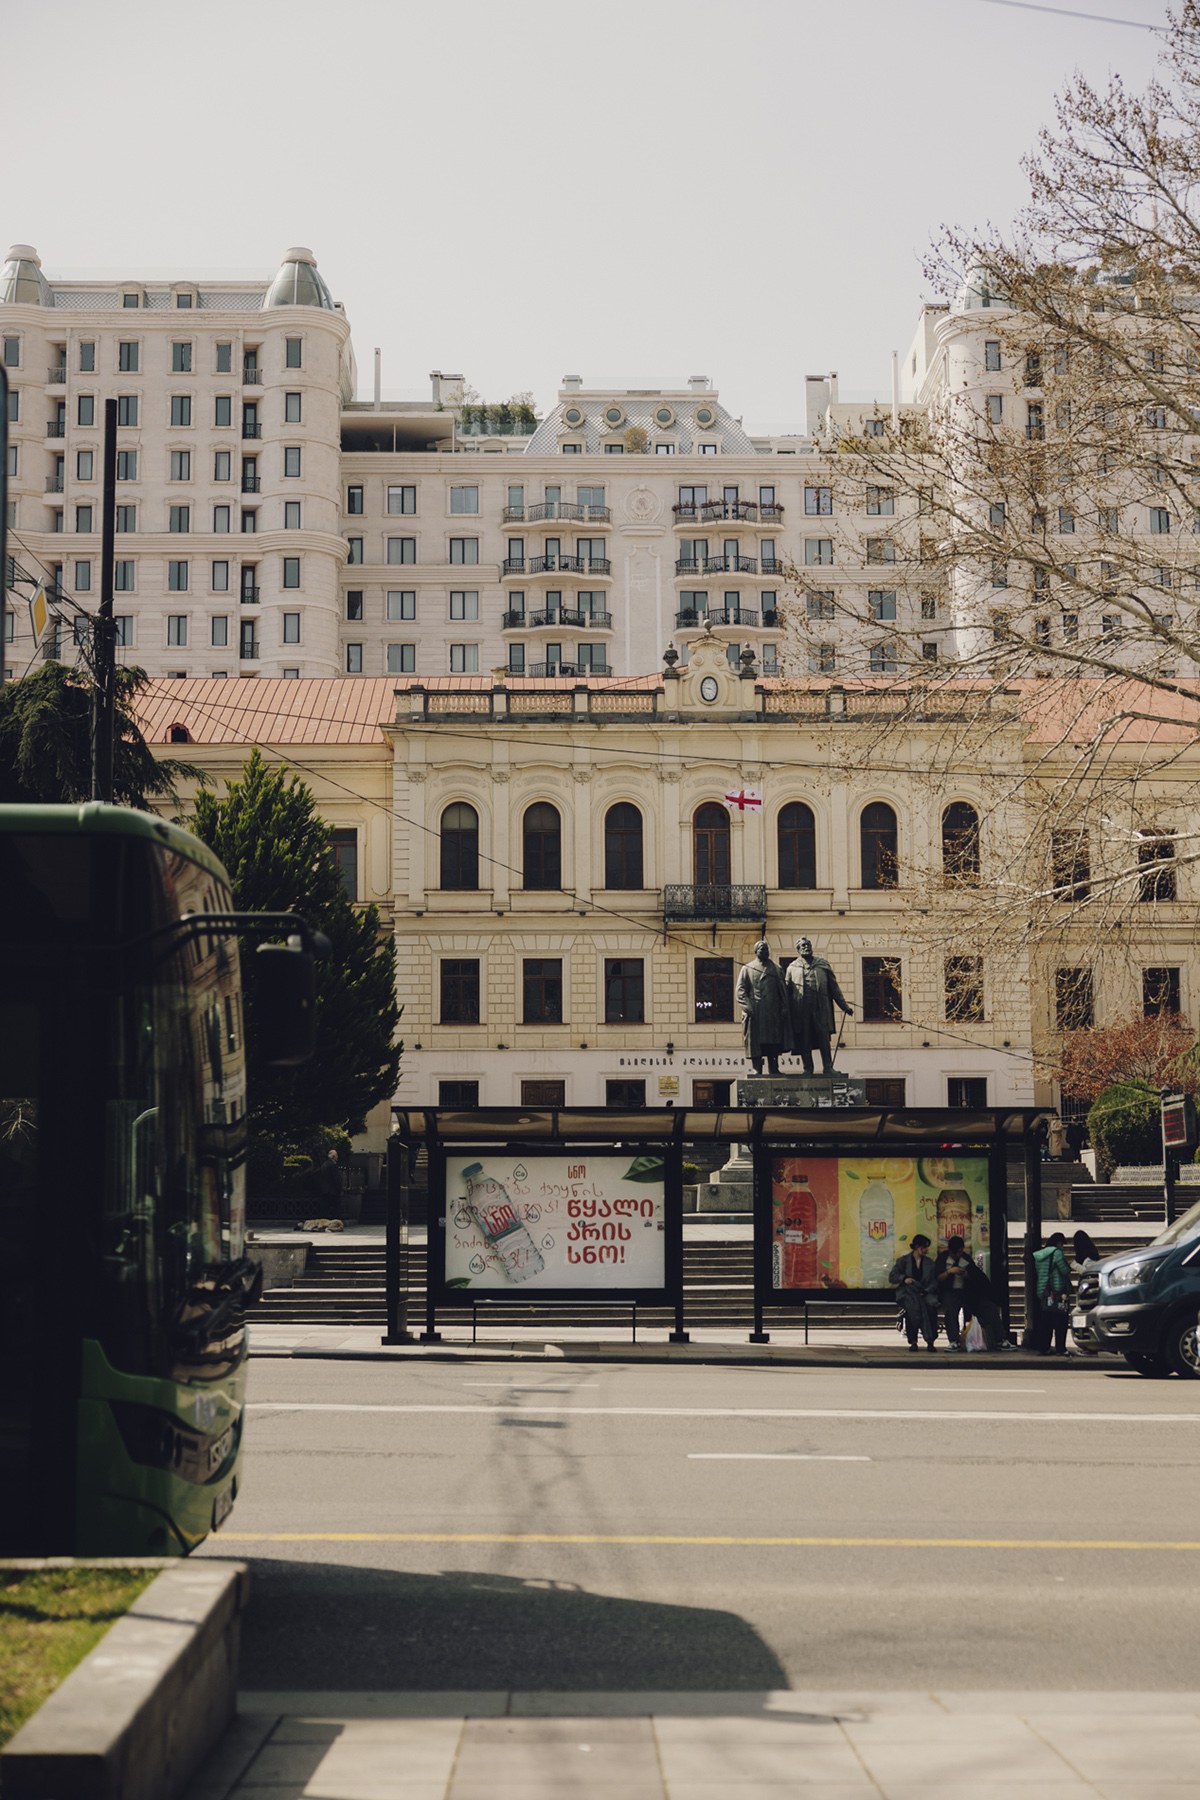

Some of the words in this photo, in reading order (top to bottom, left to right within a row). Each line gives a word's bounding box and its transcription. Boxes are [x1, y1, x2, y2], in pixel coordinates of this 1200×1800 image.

[619, 1057, 674, 1066] თბილისის
[682, 1057, 746, 1066] კლასიკური
[515, 1169, 526, 1178] Ca
[567, 1165, 586, 1179] სნო
[540, 1181, 604, 1199] ქვეყნის
[567, 1198, 654, 1218] წყალი
[483, 1204, 519, 1236] სნო
[566, 1222, 632, 1241] არის
[567, 1245, 626, 1264] სნო!
